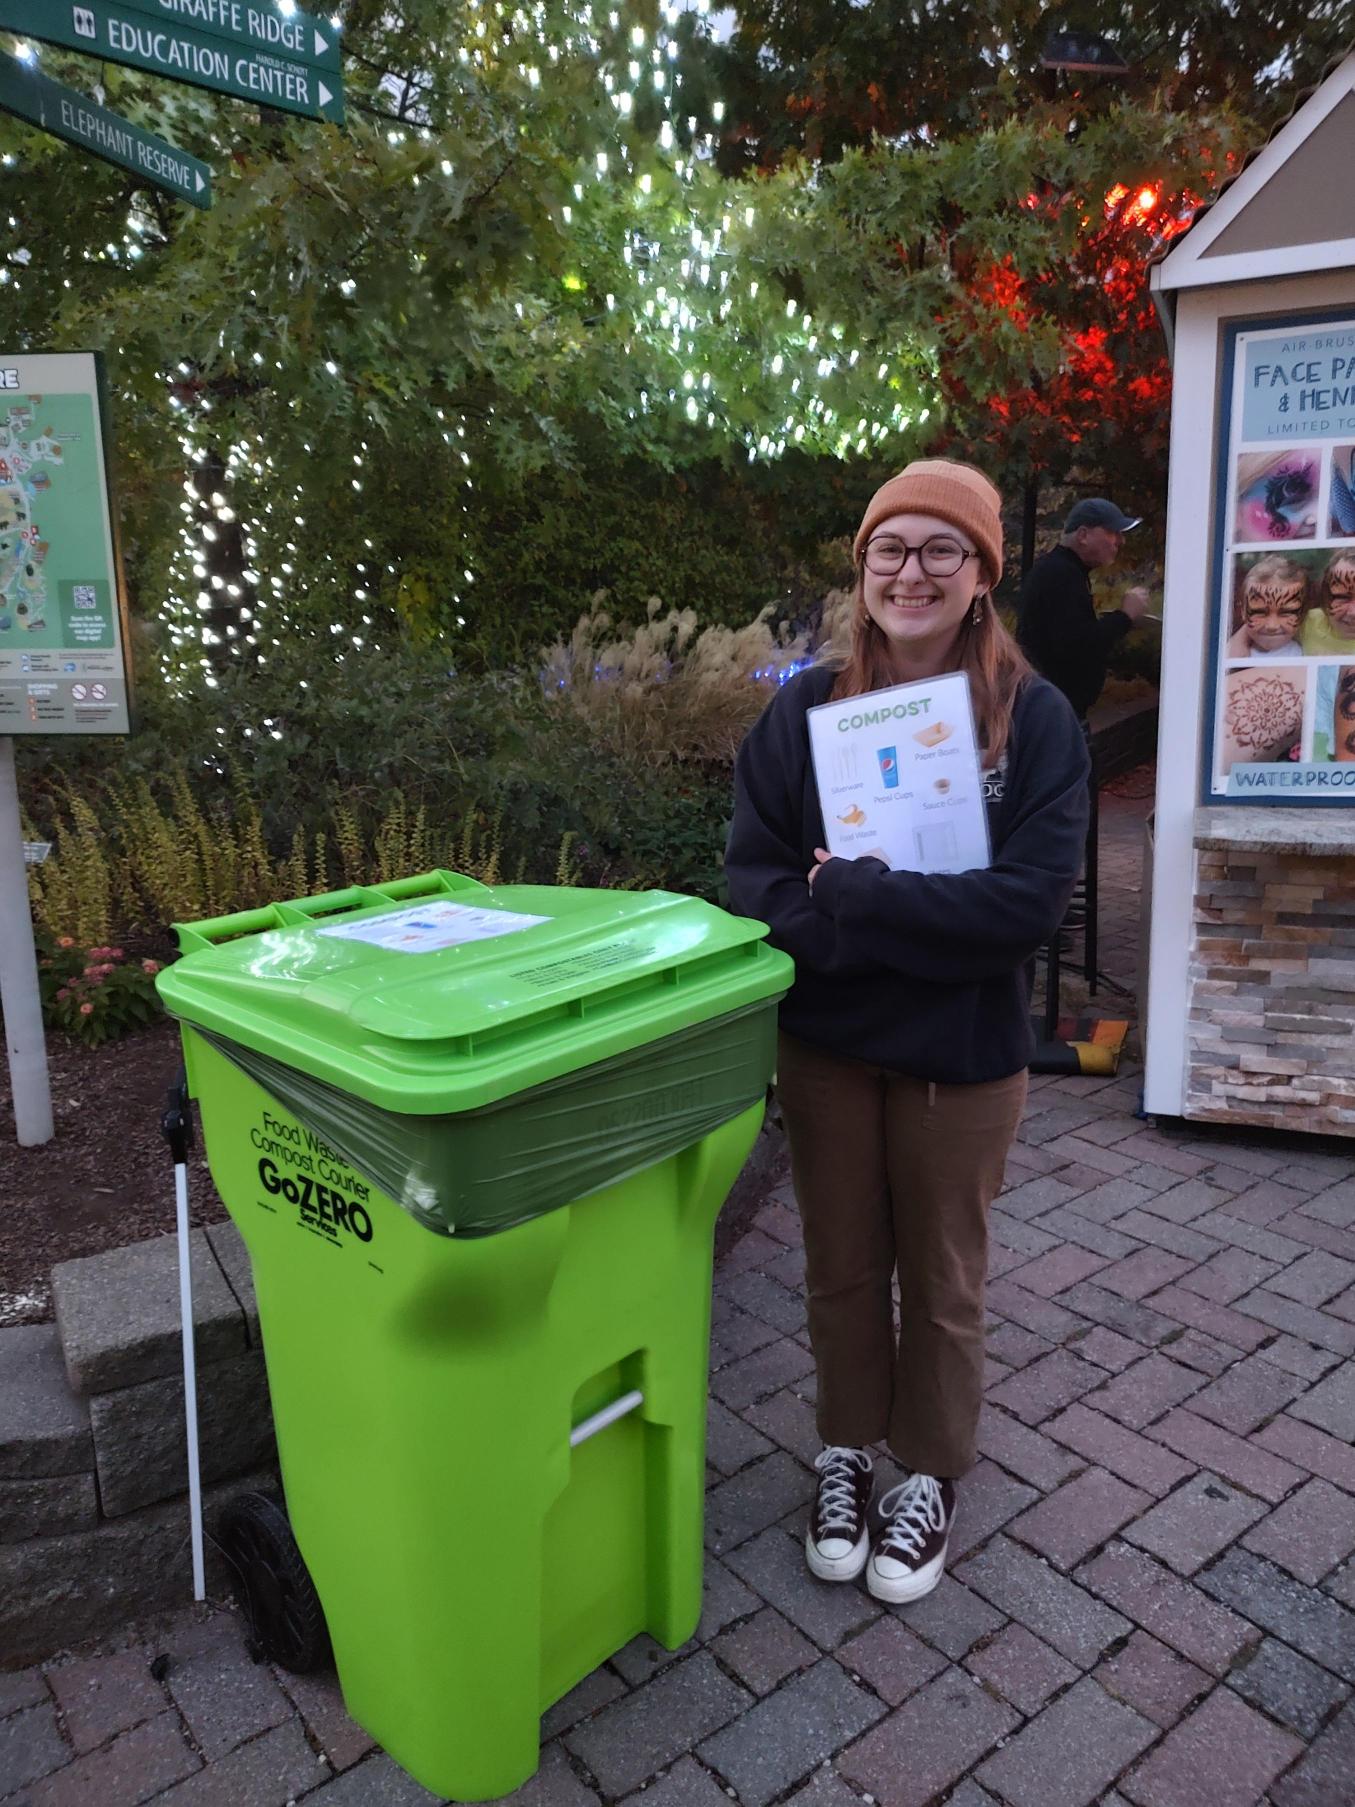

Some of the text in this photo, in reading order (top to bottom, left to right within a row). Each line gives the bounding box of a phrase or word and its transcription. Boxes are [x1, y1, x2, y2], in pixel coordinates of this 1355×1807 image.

[247, 8, 305, 52] RIDGE
[108, 18, 310, 104] EDUCATION CENTER
[61, 100, 191, 189] ELEPHANT RESERVE
[1254, 361, 1322, 388] FACE
[1278, 385, 1355, 413] & HEN
[1267, 420, 1330, 435] LIMITED
[837, 697, 932, 733] COMPOST
[914, 751, 936, 761] Paper
[831, 781, 864, 795] Silverware
[1235, 770, 1355, 787] WATERPROO
[896, 790, 914, 802] Cups
[922, 799, 945, 811] Sauce
[262, 1111, 351, 1170] Food Waste
[250, 1127, 371, 1202] Compost Courier
[258, 1157, 373, 1243] GoZERO
[300, 1207, 338, 1237] Services
